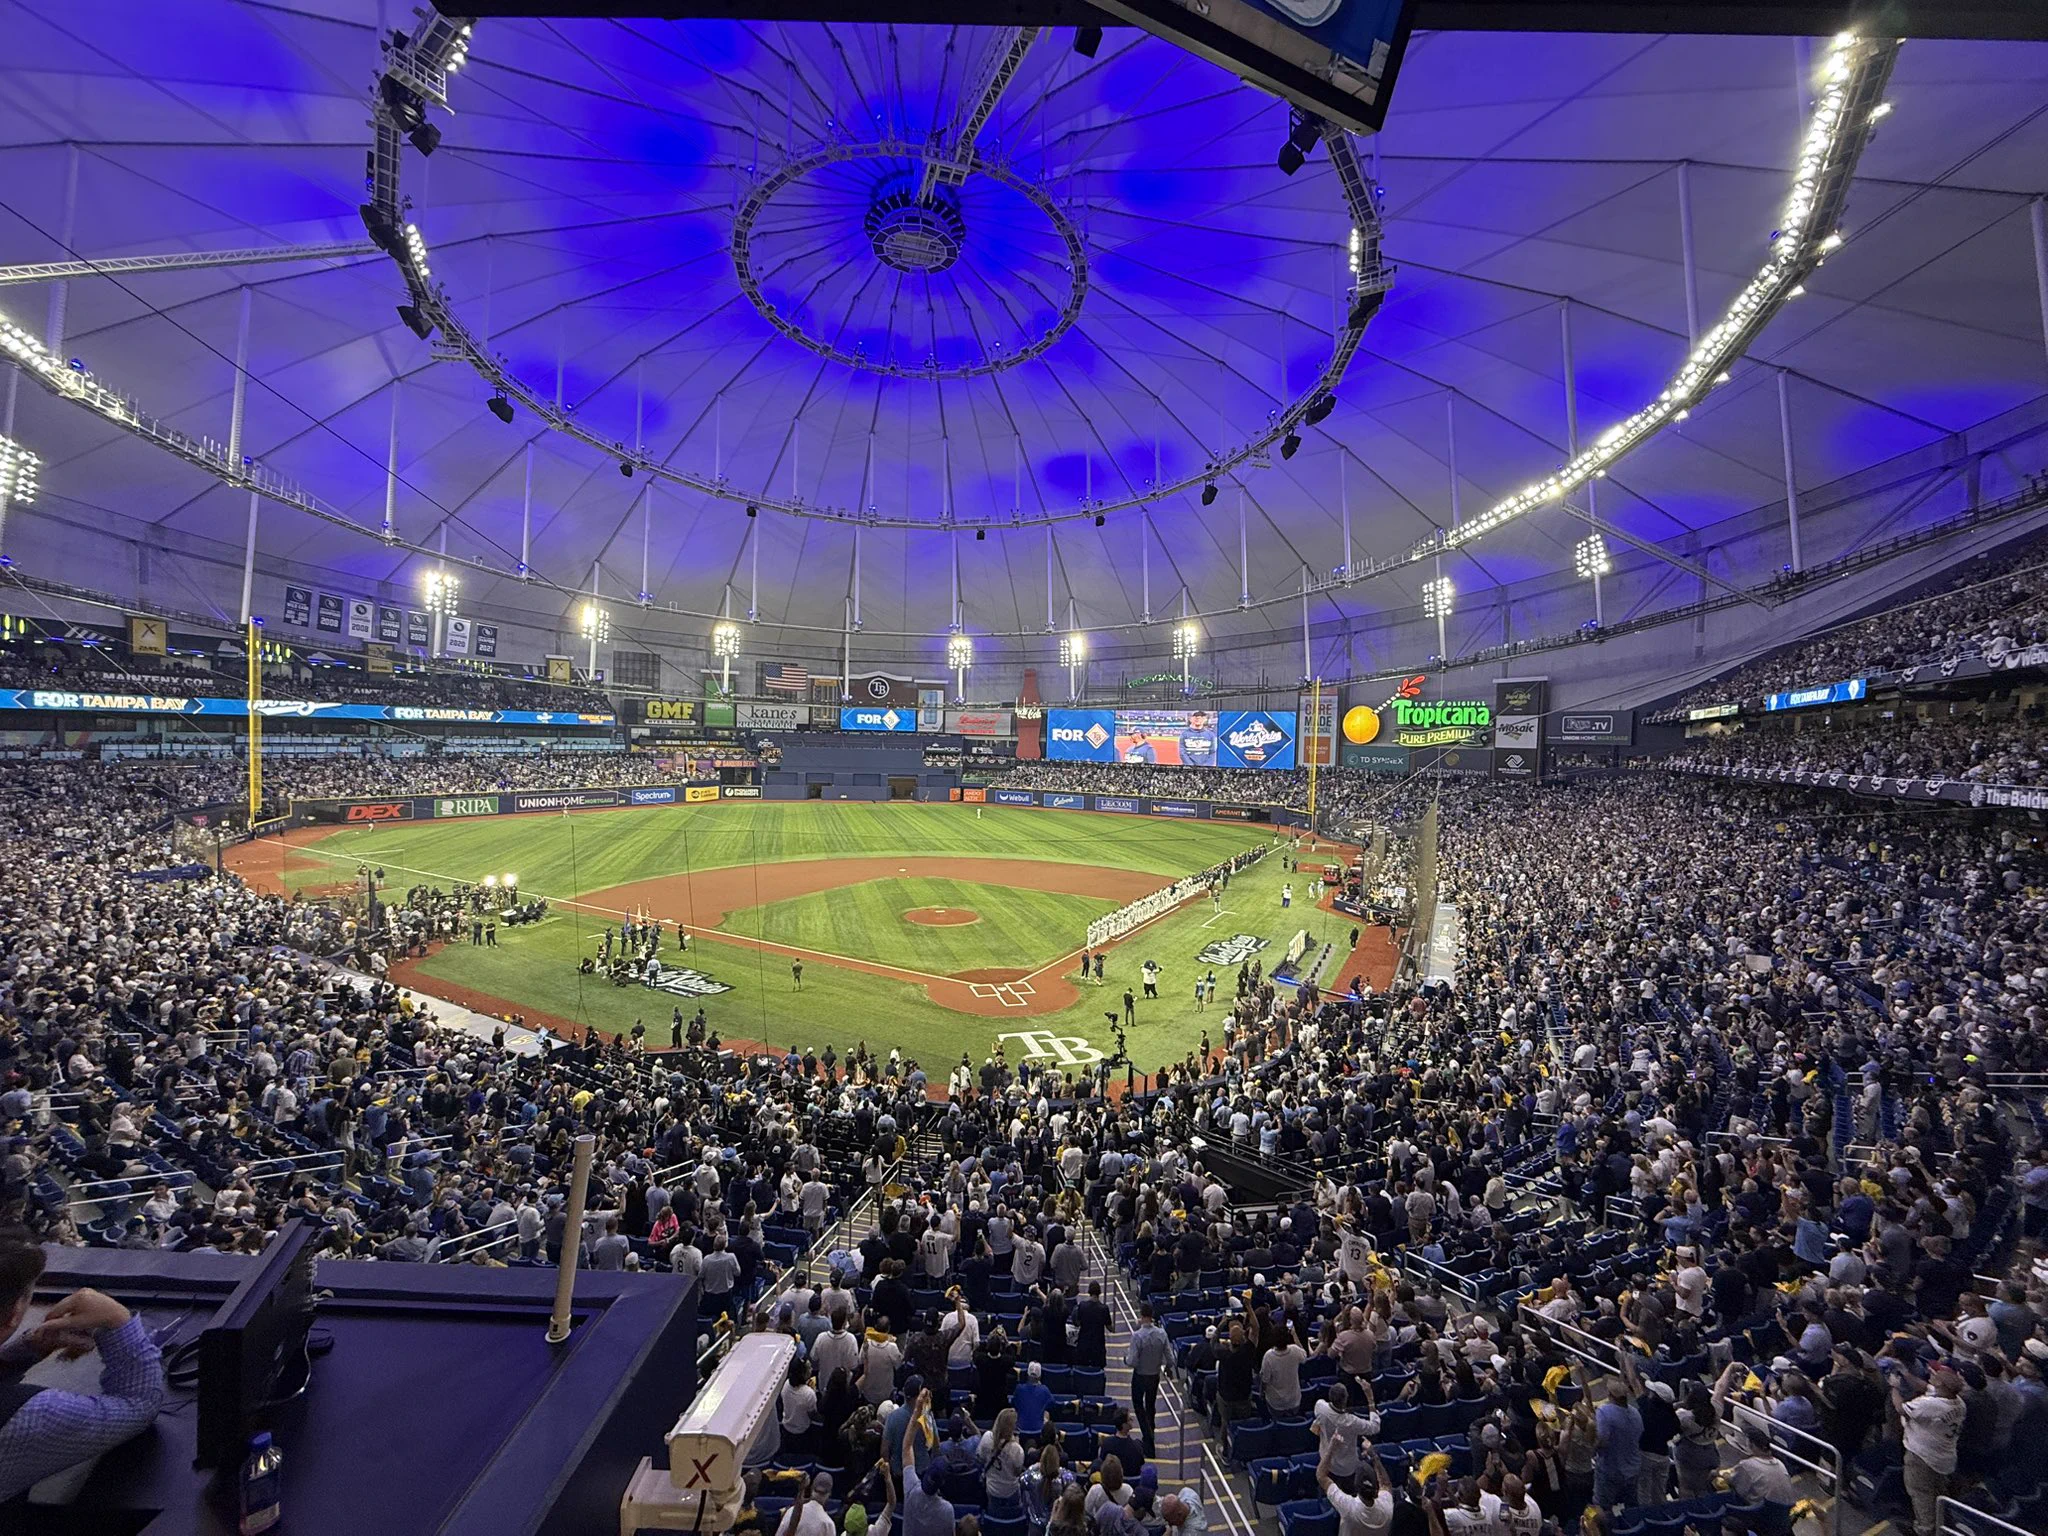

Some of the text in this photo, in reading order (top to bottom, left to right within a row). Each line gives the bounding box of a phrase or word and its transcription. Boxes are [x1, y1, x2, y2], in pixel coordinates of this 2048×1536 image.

[872, 681, 887, 696] TB
[34, 692, 189, 711] FOR TAMPA BAY
[395, 707, 494, 721] FOR TAMPA BAY
[647, 701, 694, 719] GMF
[751, 705, 798, 719] kane's
[1392, 700, 1490, 728] Tropicana
[857, 714, 881, 724] FOR
[1052, 728, 1084, 741] FOR
[1400, 729, 1475, 745] PURE PREMIUM
[635, 791, 668, 802] Spectrum
[1986, 789, 2011, 806] The
[456, 799, 493, 814] RIPA
[1101, 800, 1132, 808] LECOM
[347, 804, 402, 820] DEX
[998, 1030, 1105, 1066] TB
[926, 1241, 937, 1255] 11
[1350, 1248, 1361, 1260] 13
[677, 1260, 684, 1272] 8
[1024, 1255, 1033, 1266] 2
